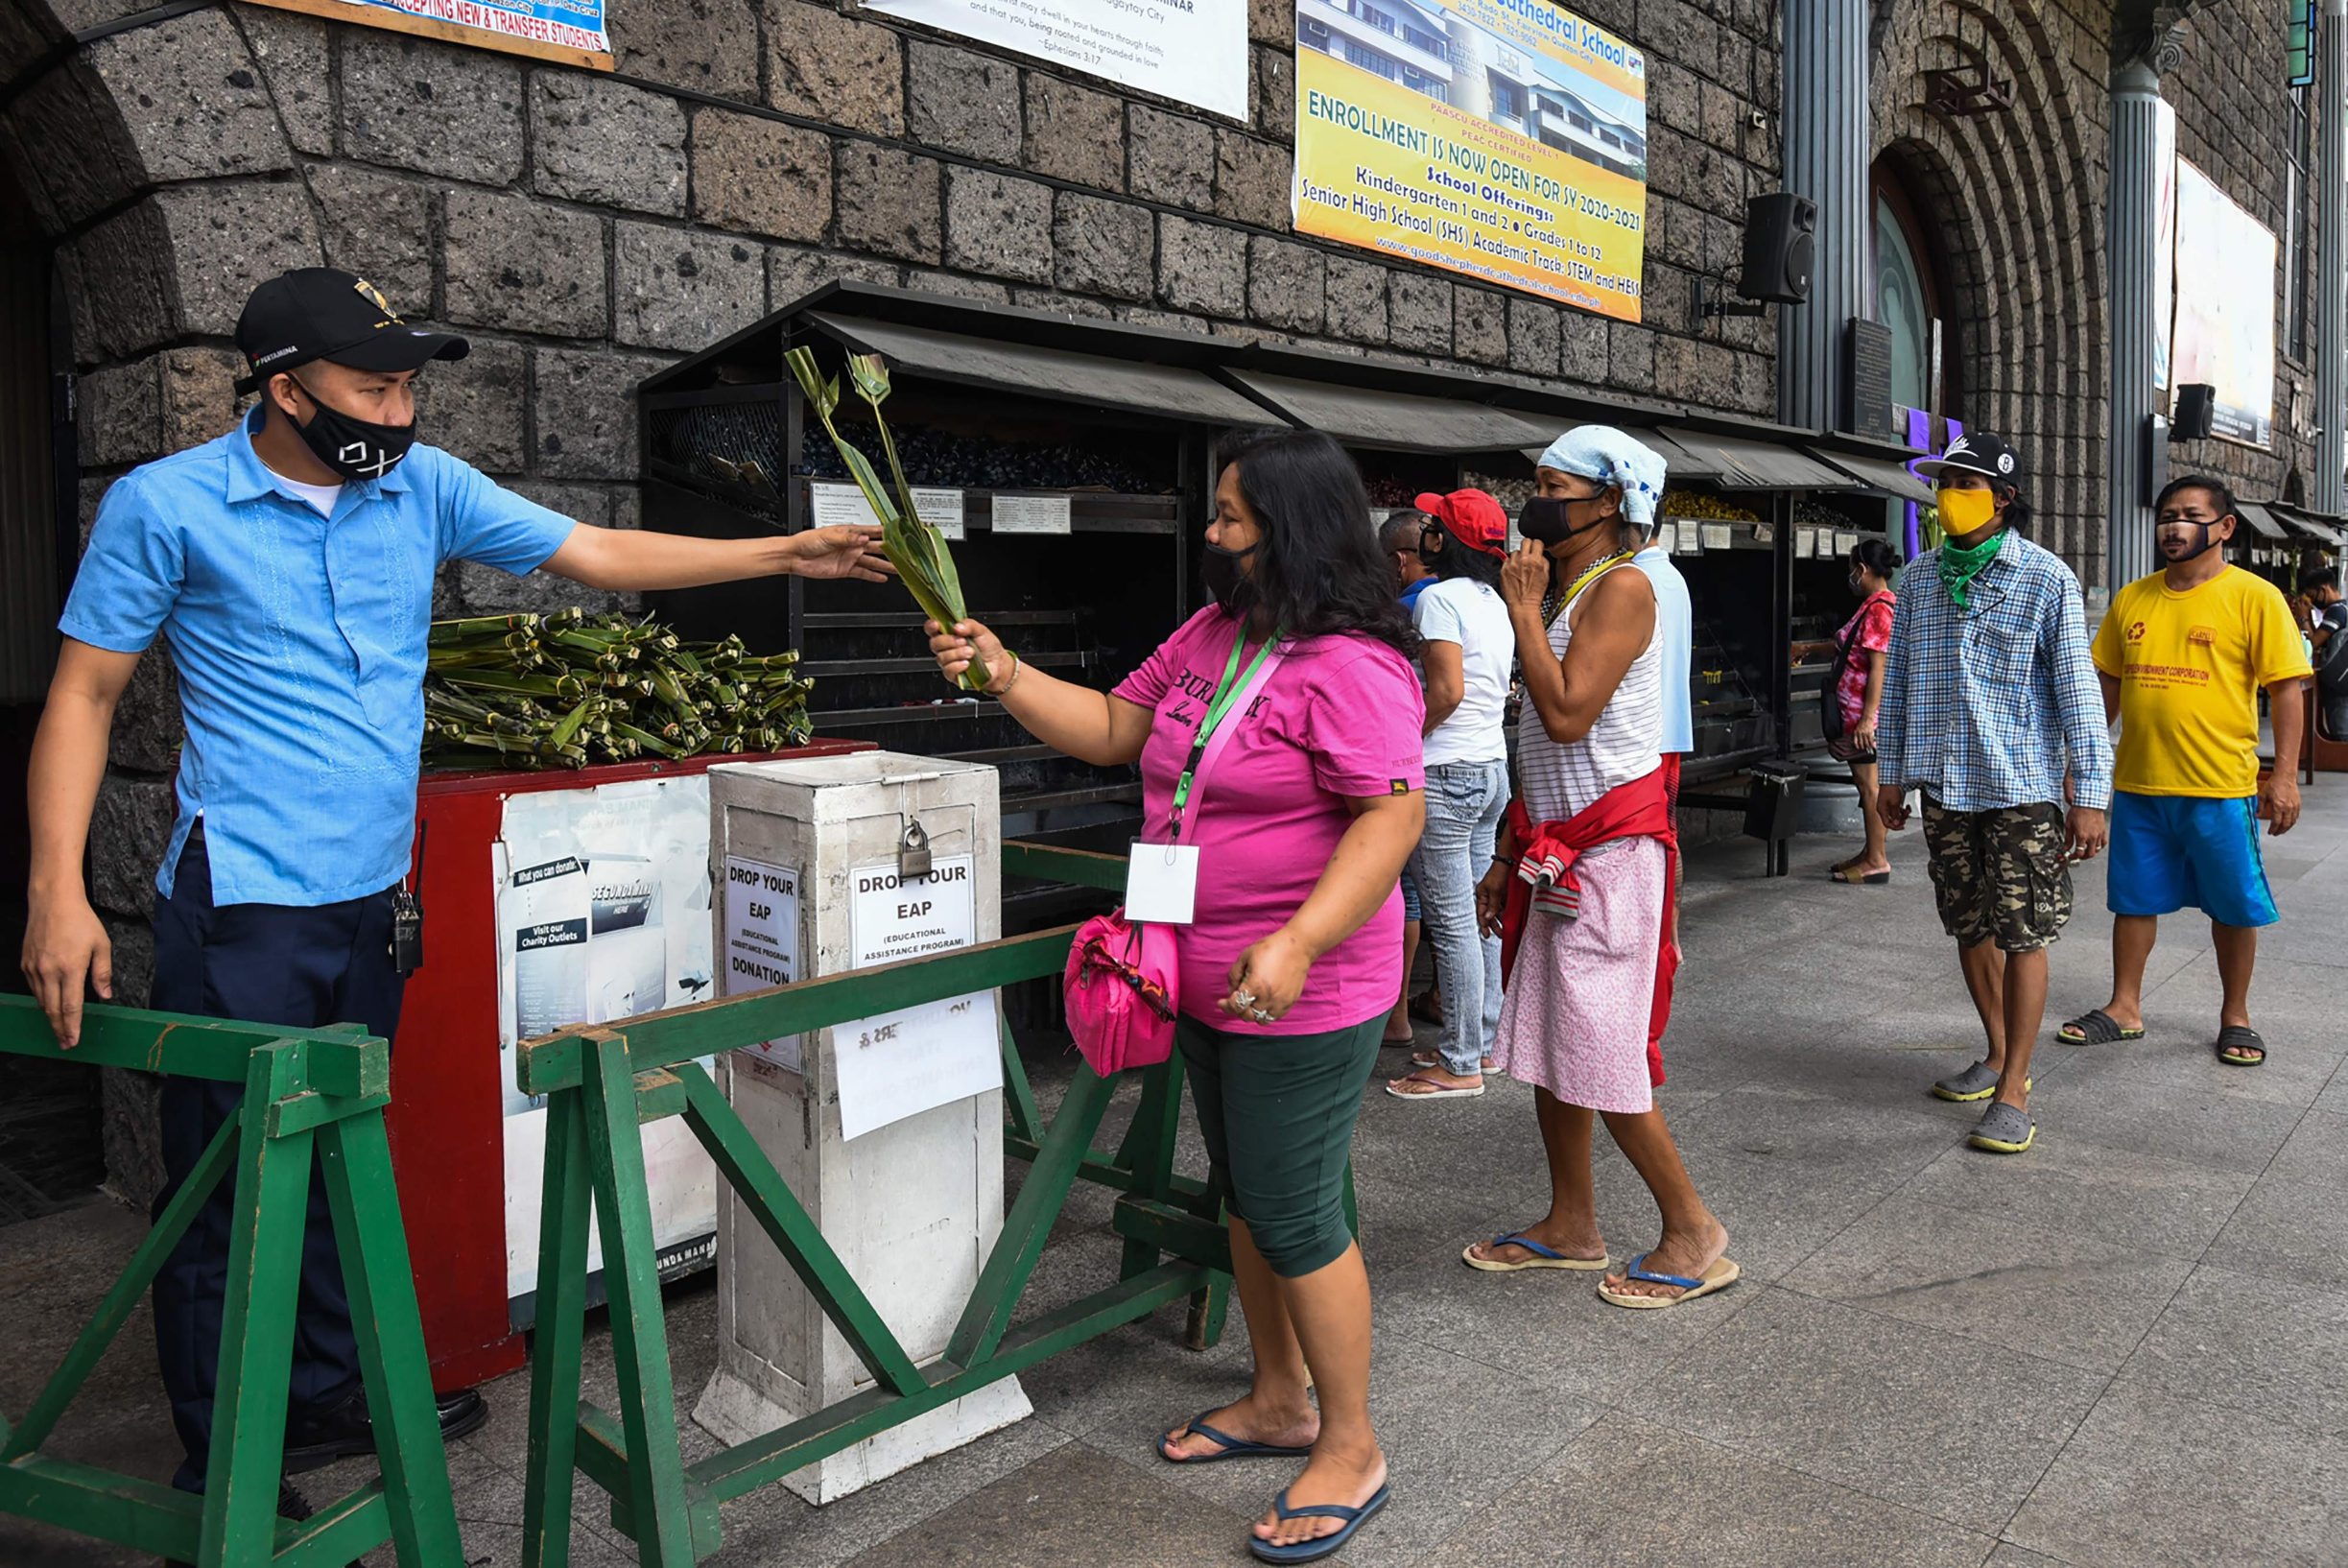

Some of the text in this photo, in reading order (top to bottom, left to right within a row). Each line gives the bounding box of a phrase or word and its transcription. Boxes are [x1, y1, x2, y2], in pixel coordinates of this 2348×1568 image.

[457, 1, 481, 26] NEW
[484, 8, 491, 29] &
[493, 10, 549, 41] TRANSFER
[551, 22, 603, 50] STUDENTS
[1147, 7, 1164, 24] City
[970, 2, 987, 12] and
[989, 6, 1007, 18] that
[1009, 14, 1027, 27] you,
[1029, 17, 1053, 36] being
[1055, 29, 1080, 43] rooted
[1081, 38, 1097, 49] and
[1098, 44, 1134, 61] grounded
[1144, 57, 1158, 69] love
[1090, 24, 1114, 39] hearts
[1116, 33, 1144, 50] through
[1497, 0, 1625, 68] athedral School
[1083, 51, 1101, 65] 3:17
[1579, 51, 1595, 65] City
[1431, 98, 1468, 125] PAASCU
[1470, 119, 1526, 148] ACCREDITED
[1528, 141, 1553, 158] LEVEL
[1309, 90, 1641, 231] ENROLLMENT IS NOW OPEN FOR SY 2020-2021
[1461, 130, 1532, 163] PEAC CERTIFIED
[1428, 166, 1555, 223] School Offerings:
[1356, 166, 1458, 214] Kindergarten
[1462, 202, 1467, 217] 1
[1471, 206, 1497, 226] and
[1501, 216, 1508, 230] 2
[1524, 222, 1566, 249] Grades
[1577, 242, 1588, 256] to
[1591, 247, 1601, 261] 12
[1302, 178, 1347, 210] Senior
[1352, 194, 1387, 222] High
[1391, 205, 1432, 234] School
[1436, 219, 1470, 249] (SHS)
[1473, 231, 1530, 264] Academic
[1532, 249, 1565, 274] Track:
[1567, 260, 1593, 283] STEM
[1596, 274, 1614, 290] and
[730, 866, 794, 896] DROP YOUR
[749, 902, 771, 920] EAP
[897, 900, 933, 919] EAP
[522, 932, 578, 947] Charity Outlets
[533, 924, 564, 936] Visit our
[884, 928, 946, 945] (EDUCATIONAL
[865, 938, 964, 961] ASSISTANCE PROGRAM)
[732, 956, 790, 985] DONATION
